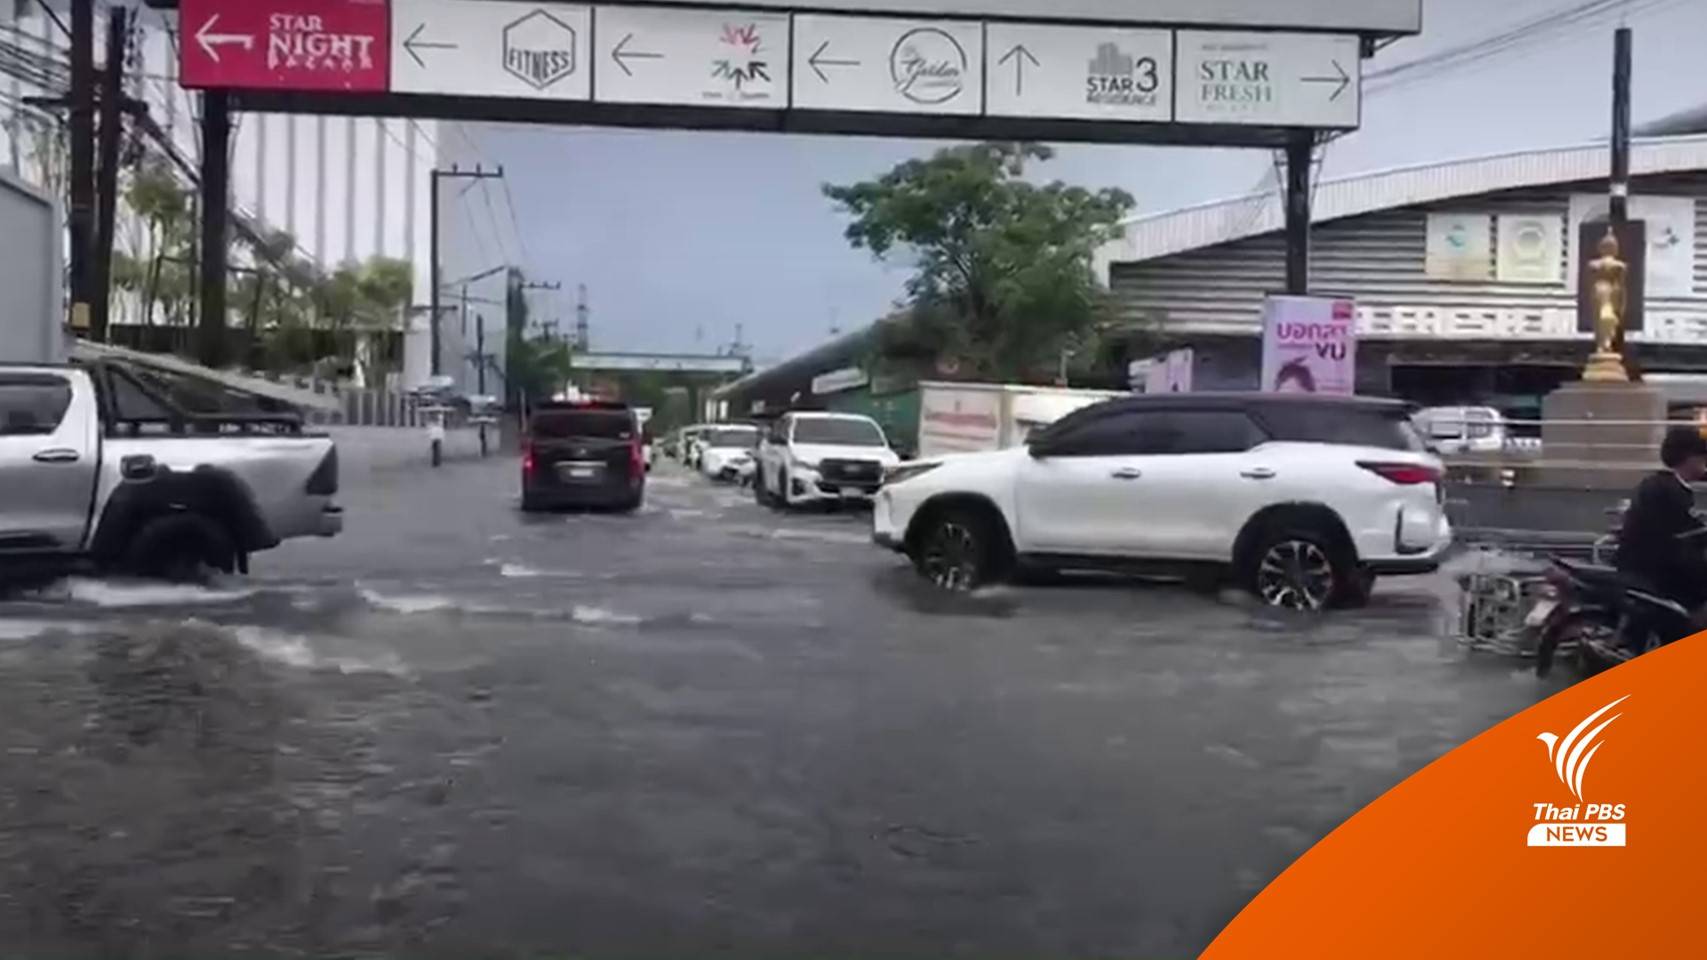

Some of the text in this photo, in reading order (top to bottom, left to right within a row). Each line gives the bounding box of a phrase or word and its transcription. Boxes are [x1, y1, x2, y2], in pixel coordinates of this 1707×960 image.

[269, 13, 323, 31] STAR
[268, 33, 375, 57] NIGHT
[509, 48, 570, 82] FITNESS
[1086, 57, 1158, 93] STAR 3
[1201, 60, 1269, 81] STAR
[1201, 83, 1272, 103] FRESH
